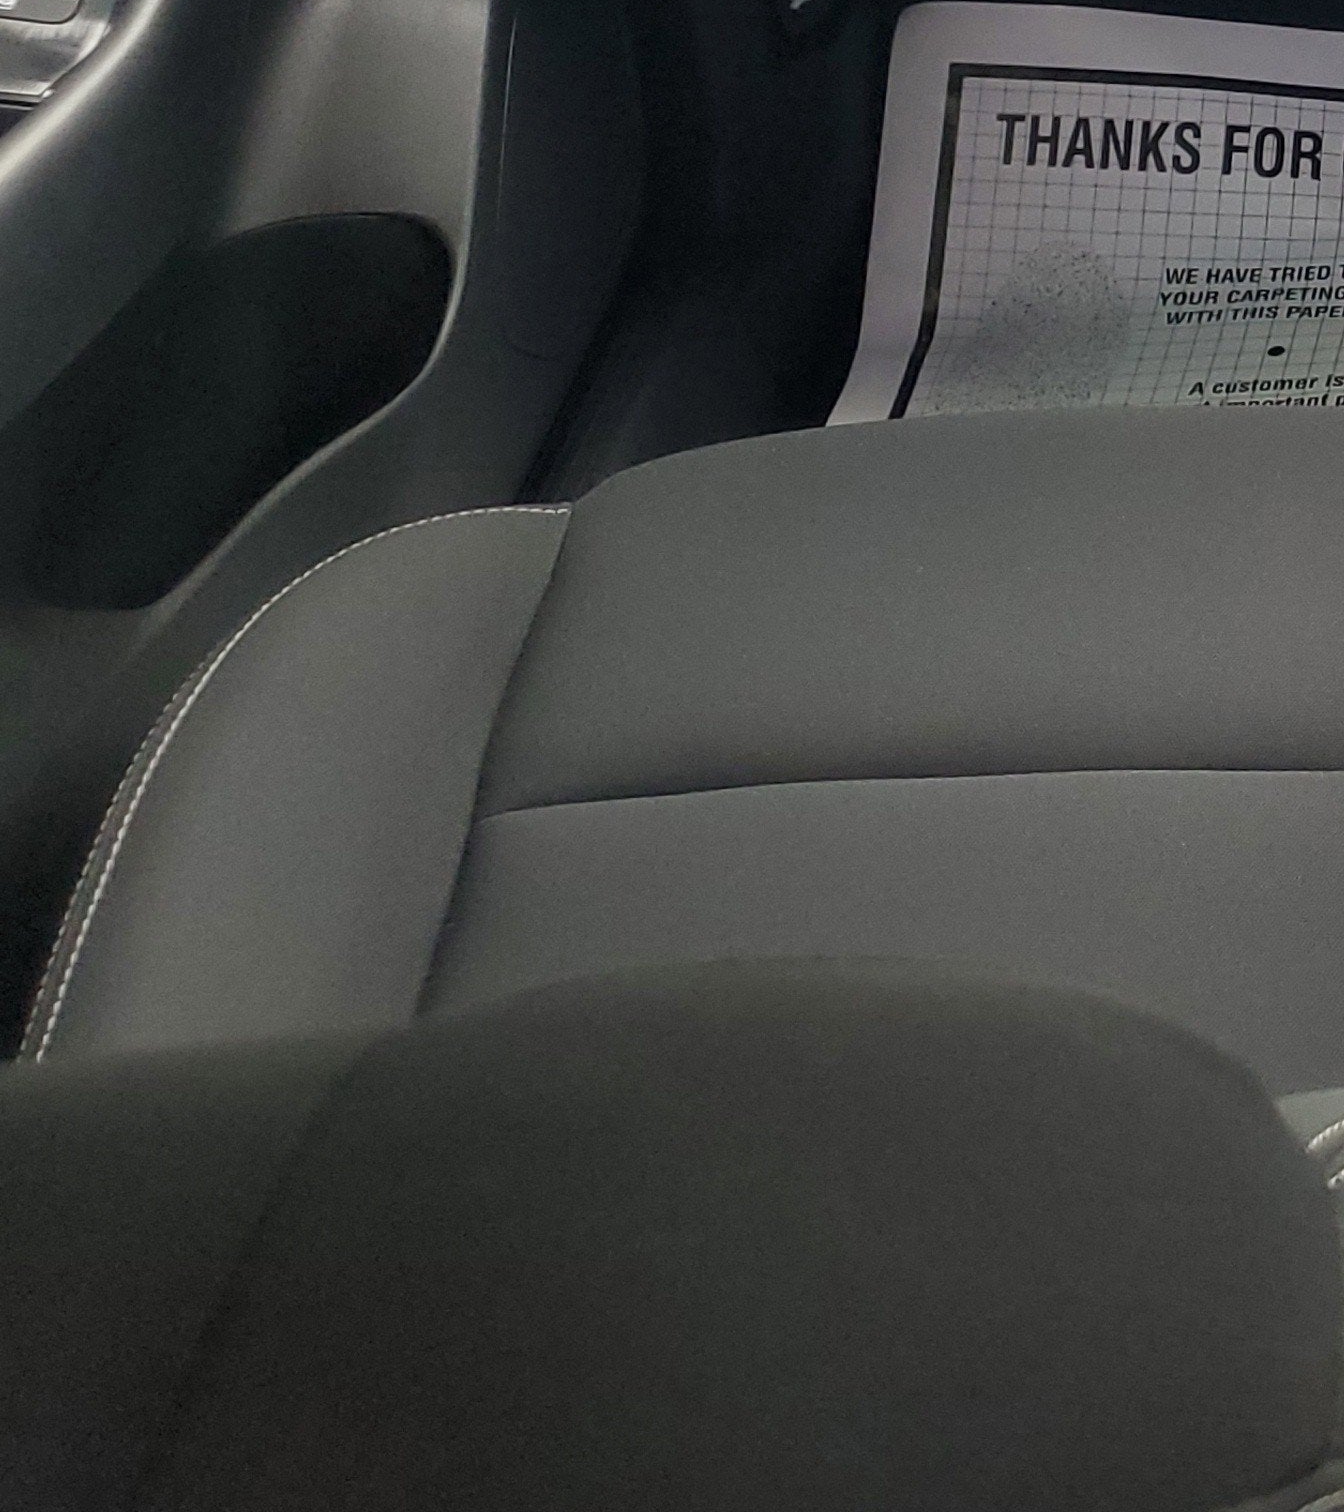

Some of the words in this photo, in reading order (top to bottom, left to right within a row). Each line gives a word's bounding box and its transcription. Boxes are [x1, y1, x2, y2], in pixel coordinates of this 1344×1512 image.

[996, 113, 1201, 174] THANKS
[1221, 125, 1323, 181] FOR
[1165, 268, 1199, 285] WE
[1206, 268, 1263, 284] HAVE
[1269, 265, 1331, 283] TRIED
[1160, 290, 1219, 306] YOUR
[1165, 309, 1222, 325] WITH
[1231, 305, 1278, 321] THIS
[1188, 382, 1204, 395] A
[1212, 377, 1318, 394] customer
